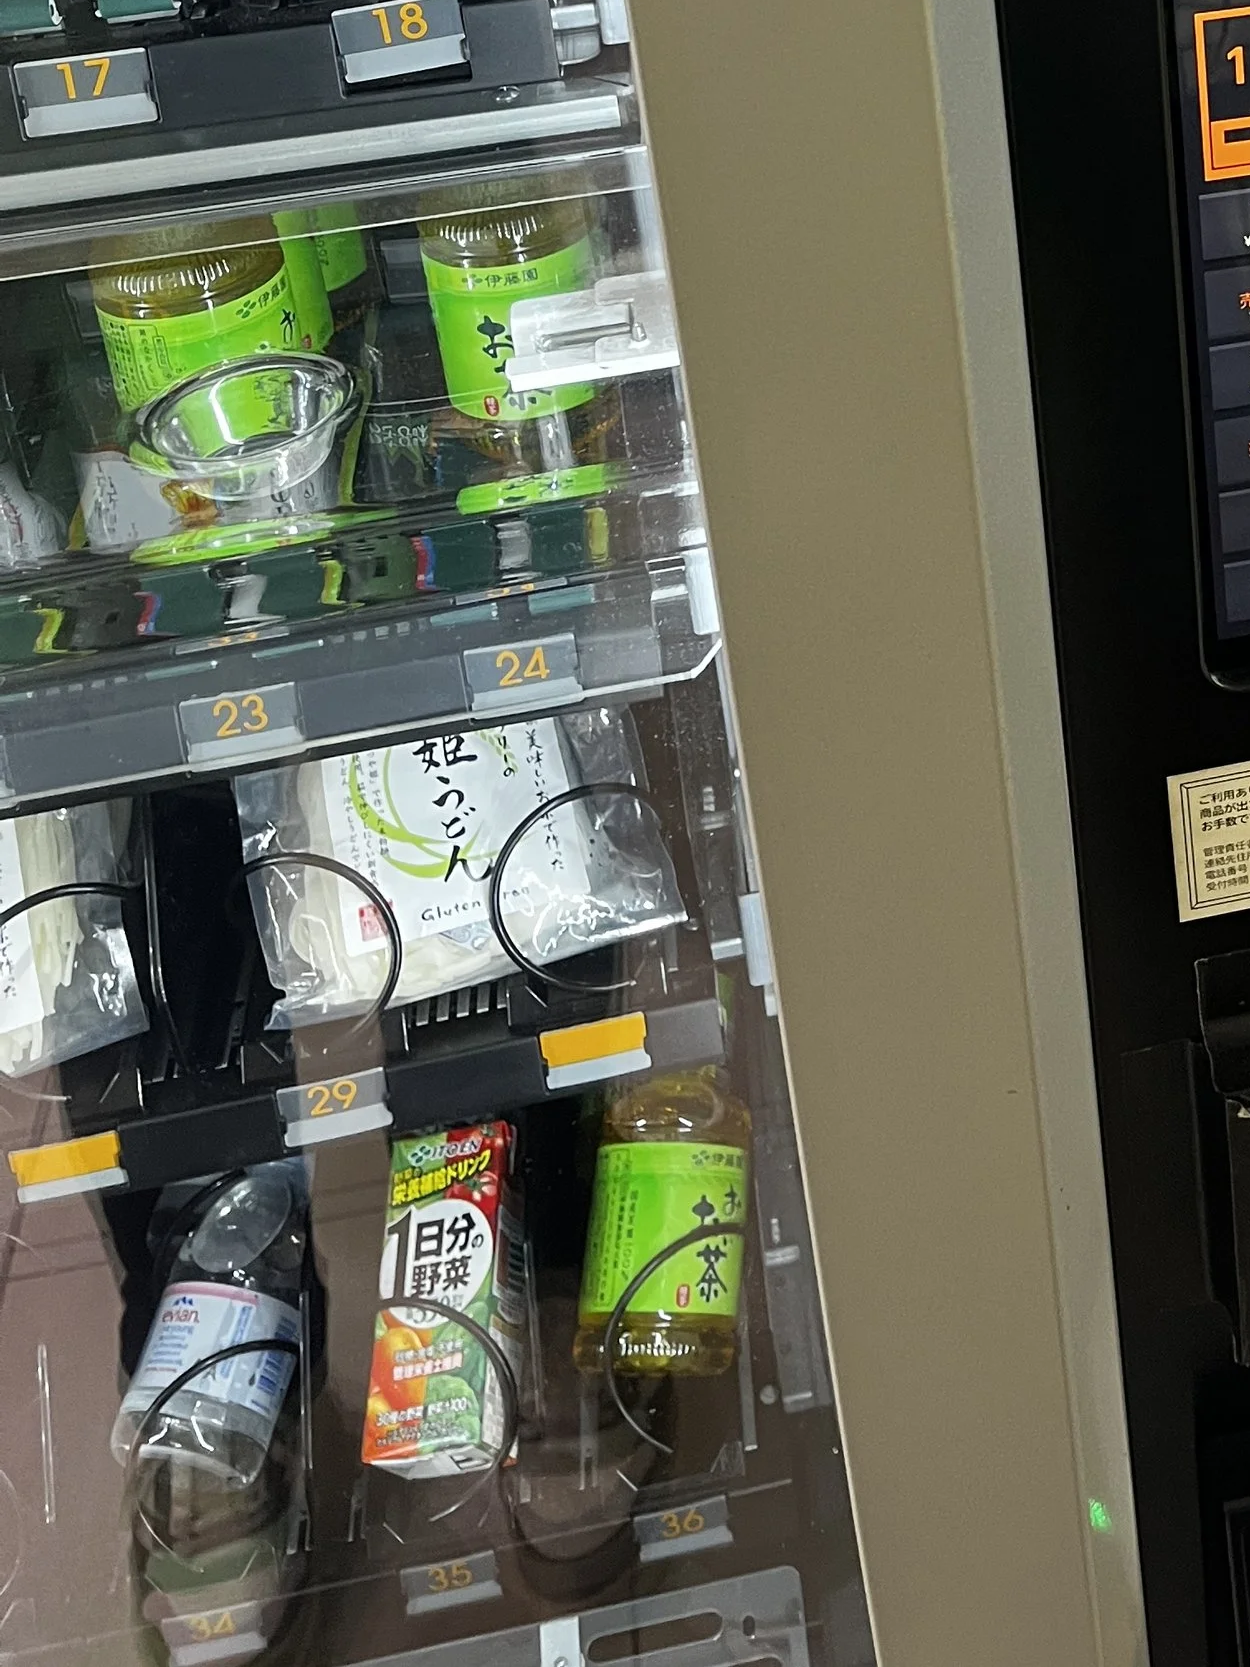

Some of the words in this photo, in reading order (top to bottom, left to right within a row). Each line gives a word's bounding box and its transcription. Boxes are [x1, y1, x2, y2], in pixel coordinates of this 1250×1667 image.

[372, 3, 430, 44] 18
[57, 58, 110, 101] 17
[1226, 45, 1246, 85] 1
[484, 268, 538, 288] 伊藤園
[496, 646, 550, 686] 24
[212, 694, 268, 737] 23
[1205, 875, 1249, 892] 受付時間
[420, 898, 481, 921] Gluten
[307, 1080, 359, 1118] 29
[412, 1255, 472, 1296] 野菜
[662, 1509, 704, 1537] 36
[428, 1562, 473, 1593] 35
